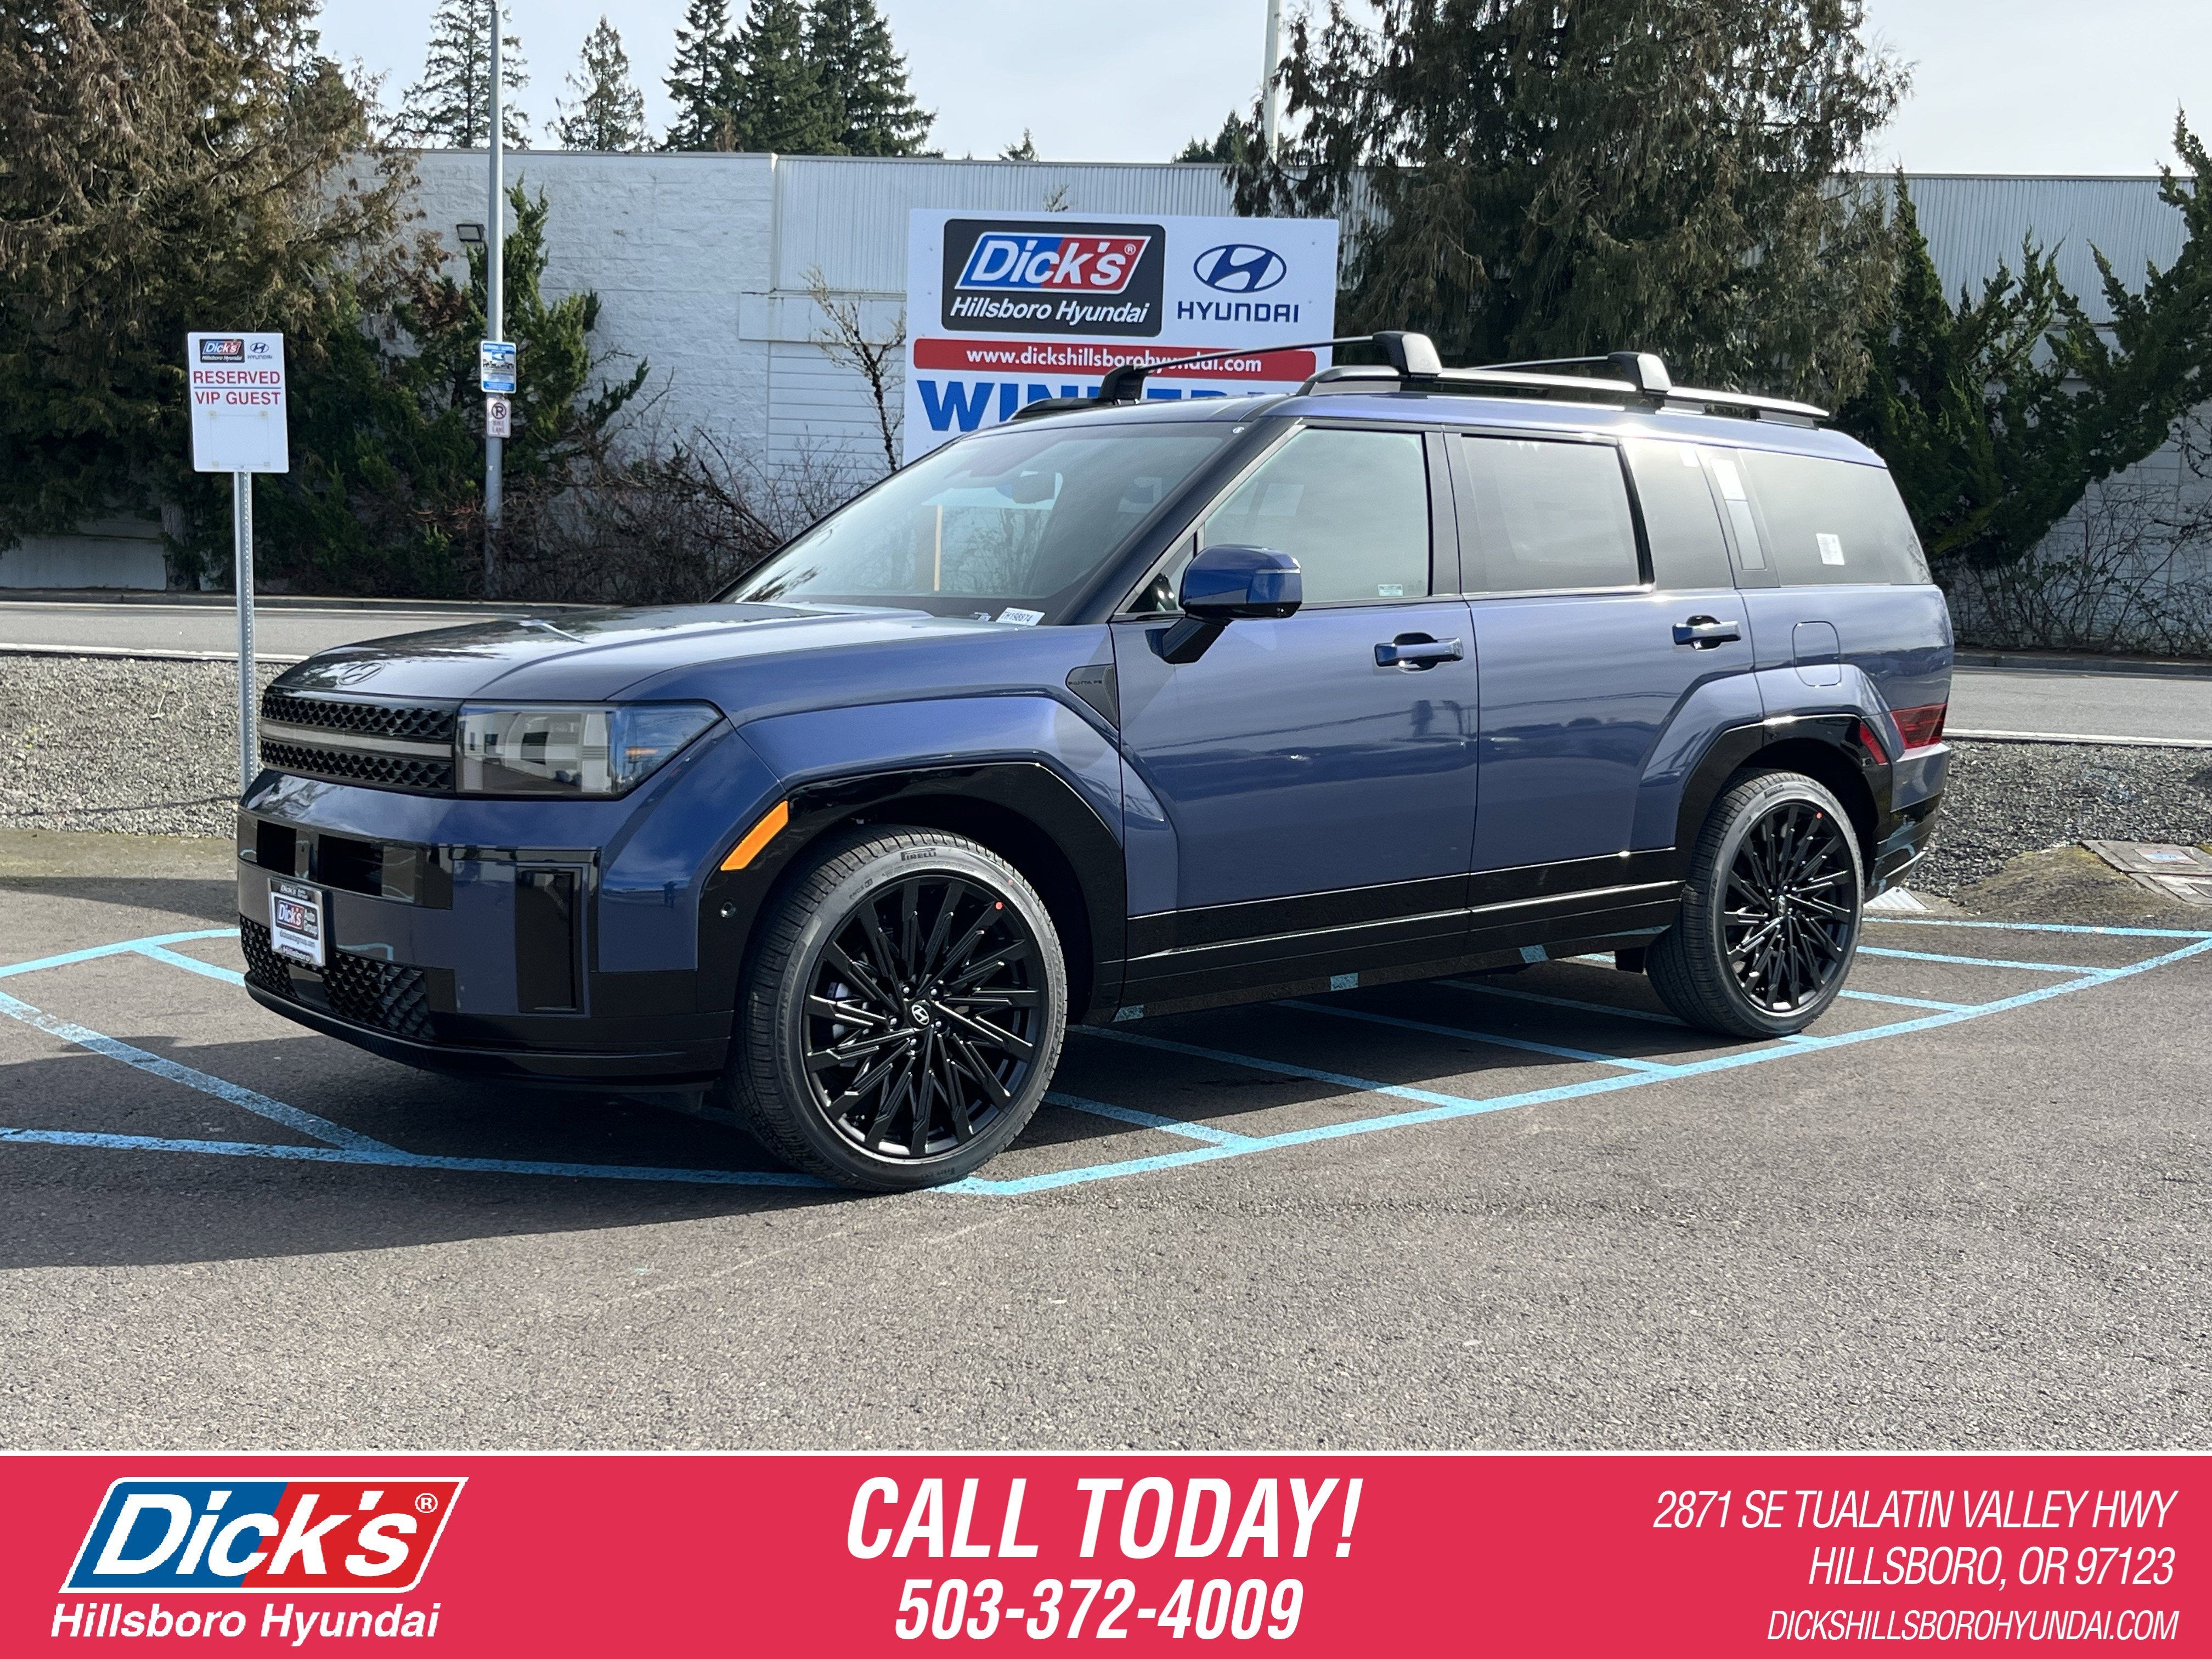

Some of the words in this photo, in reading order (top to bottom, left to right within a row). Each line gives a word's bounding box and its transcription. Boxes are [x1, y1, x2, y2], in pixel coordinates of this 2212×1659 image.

[950, 297, 1052, 319] Hillsboro
[1055, 300, 1150, 326] Hyundai
[1177, 301, 1299, 323] HYUNDAI
[194, 371, 281, 384] RESERVED
[195, 392, 221, 404] VIP
[225, 392, 281, 405] GUEST
[901, 848, 937, 861] PIRELLI
